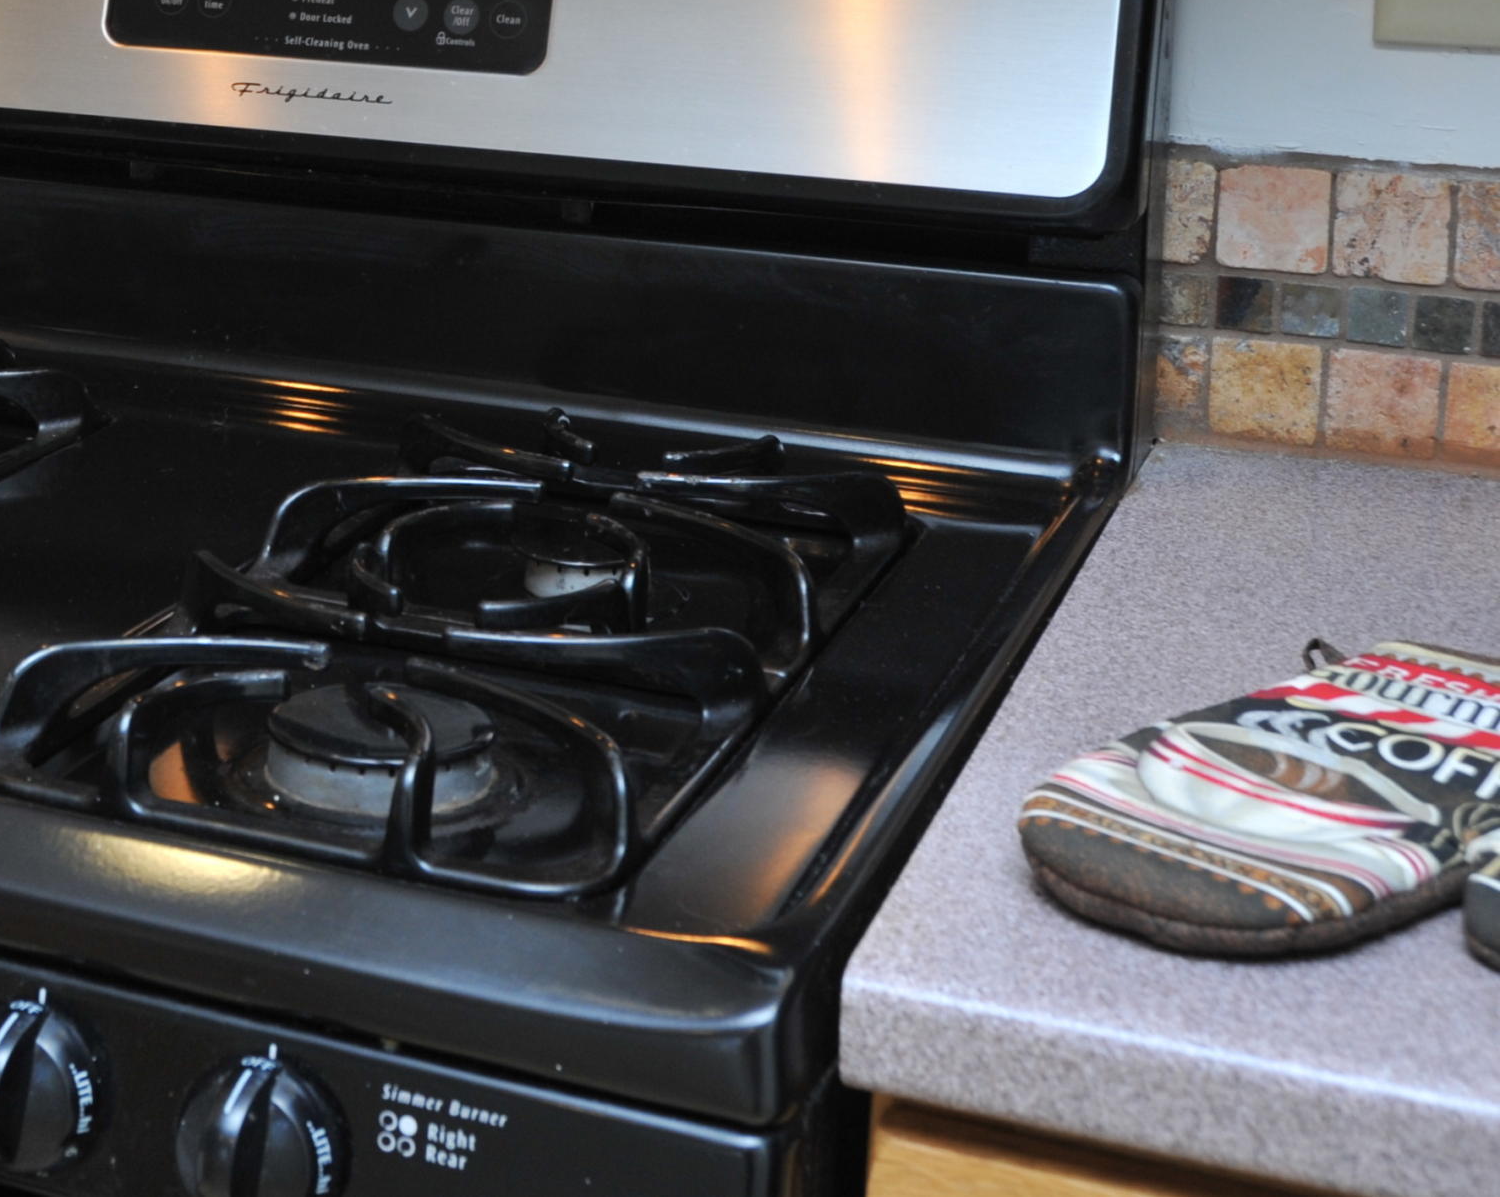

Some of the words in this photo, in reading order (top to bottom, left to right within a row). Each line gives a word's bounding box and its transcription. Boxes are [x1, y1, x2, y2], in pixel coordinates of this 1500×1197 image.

[204, 0, 224, 10] time
[451, 5, 474, 16] Clear
[300, 12, 320, 22] Door
[323, 14, 353, 24] Locked
[496, 14, 521, 25] Clean
[284, 35, 345, 51] Self-Cleaning
[347, 40, 370, 51] Oven
[231, 82, 393, 104] Frigidaire
[382, 1082, 443, 1113] Simmer
[449, 1099, 508, 1128] Burner
[427, 1122, 476, 1152] Right
[425, 1143, 467, 1171] Rear
